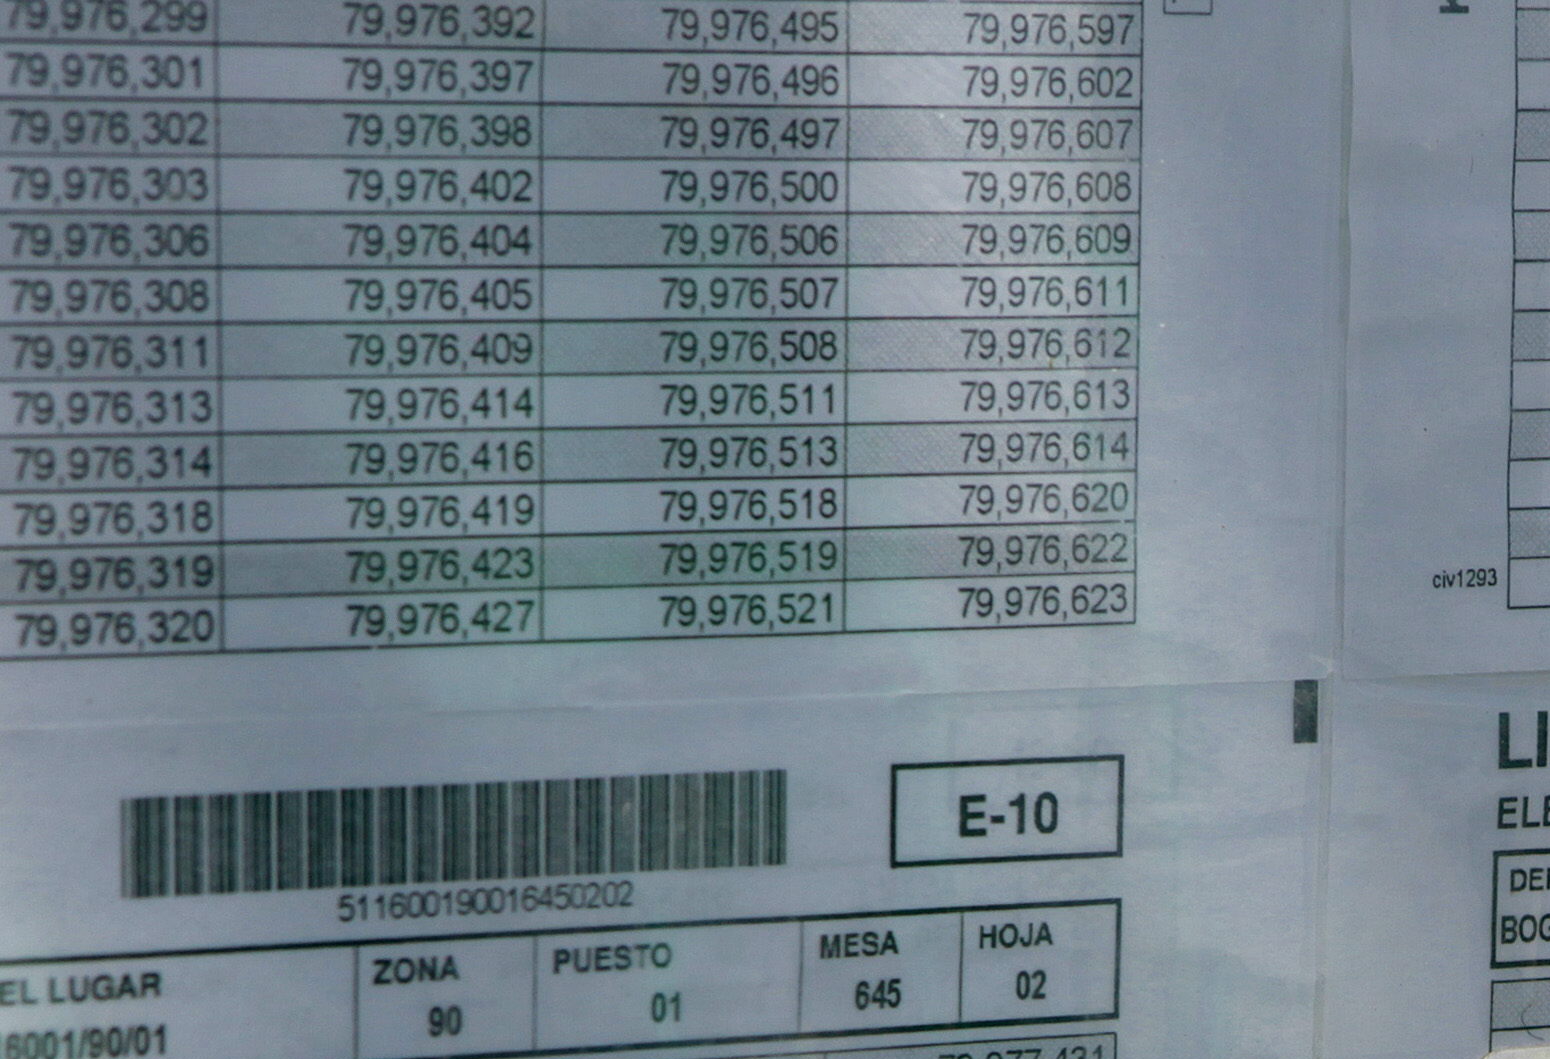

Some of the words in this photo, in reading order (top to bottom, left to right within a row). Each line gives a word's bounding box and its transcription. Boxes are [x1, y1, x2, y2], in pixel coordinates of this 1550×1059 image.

[343, 1, 535, 40] 79,976,392
[662, 8, 839, 43] 79,976,495
[7, 52, 202, 92] 79,976,301
[963, 65, 1133, 103] 79,976,602
[343, 113, 532, 153] 79,976,398
[661, 115, 840, 154] 79,976,497
[962, 171, 1131, 208] 79,976,608
[344, 223, 532, 262] 79,976,404
[661, 223, 838, 261] 79,976,506
[11, 279, 209, 317] 79,976,308
[961, 276, 1127, 312] 79,976,611
[960, 379, 1130, 416] 79,976,613
[13, 445, 212, 485] 79,976,314
[346, 440, 534, 475] 79,976,416
[660, 435, 838, 474] 79,976,513
[1432, 568, 1497, 589] civ1293
[347, 600, 534, 641] 79,976,427
[660, 593, 832, 631] 79,976,521
[958, 583, 1127, 623] 79,976,623
[15, 609, 214, 651] 79,976,320
[959, 792, 1058, 837] E-10
[820, 931, 899, 959] MESA
[979, 922, 1053, 949] HOJA
[373, 959, 459, 985] ZONA
[553, 942, 672, 974] PUESTO
[49, 972, 161, 1004] LUGAR
[855, 978, 902, 1009] 645
[1015, 970, 1046, 1000] 02
[429, 1005, 462, 1036] 90
[651, 992, 681, 1023] 01
